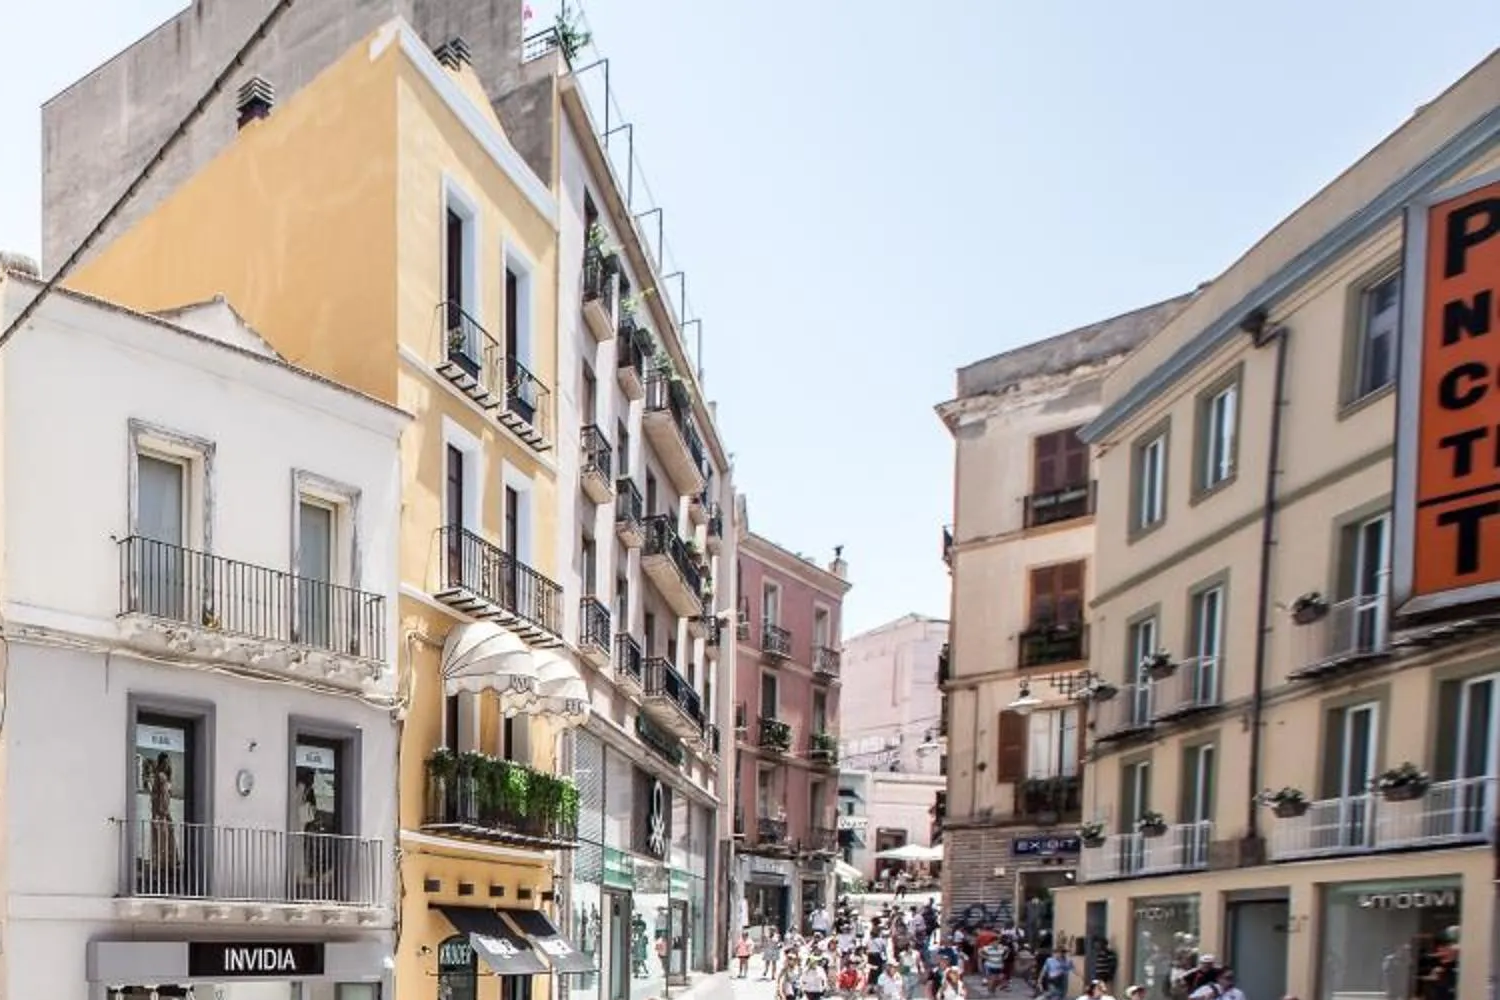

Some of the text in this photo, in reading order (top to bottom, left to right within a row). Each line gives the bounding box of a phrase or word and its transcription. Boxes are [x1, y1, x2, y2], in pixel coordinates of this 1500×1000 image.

[1442, 287, 1500, 347] N
[1439, 361, 1500, 412] C
[1438, 423, 1500, 480] T
[224, 946, 297, 972] INVIDIA
